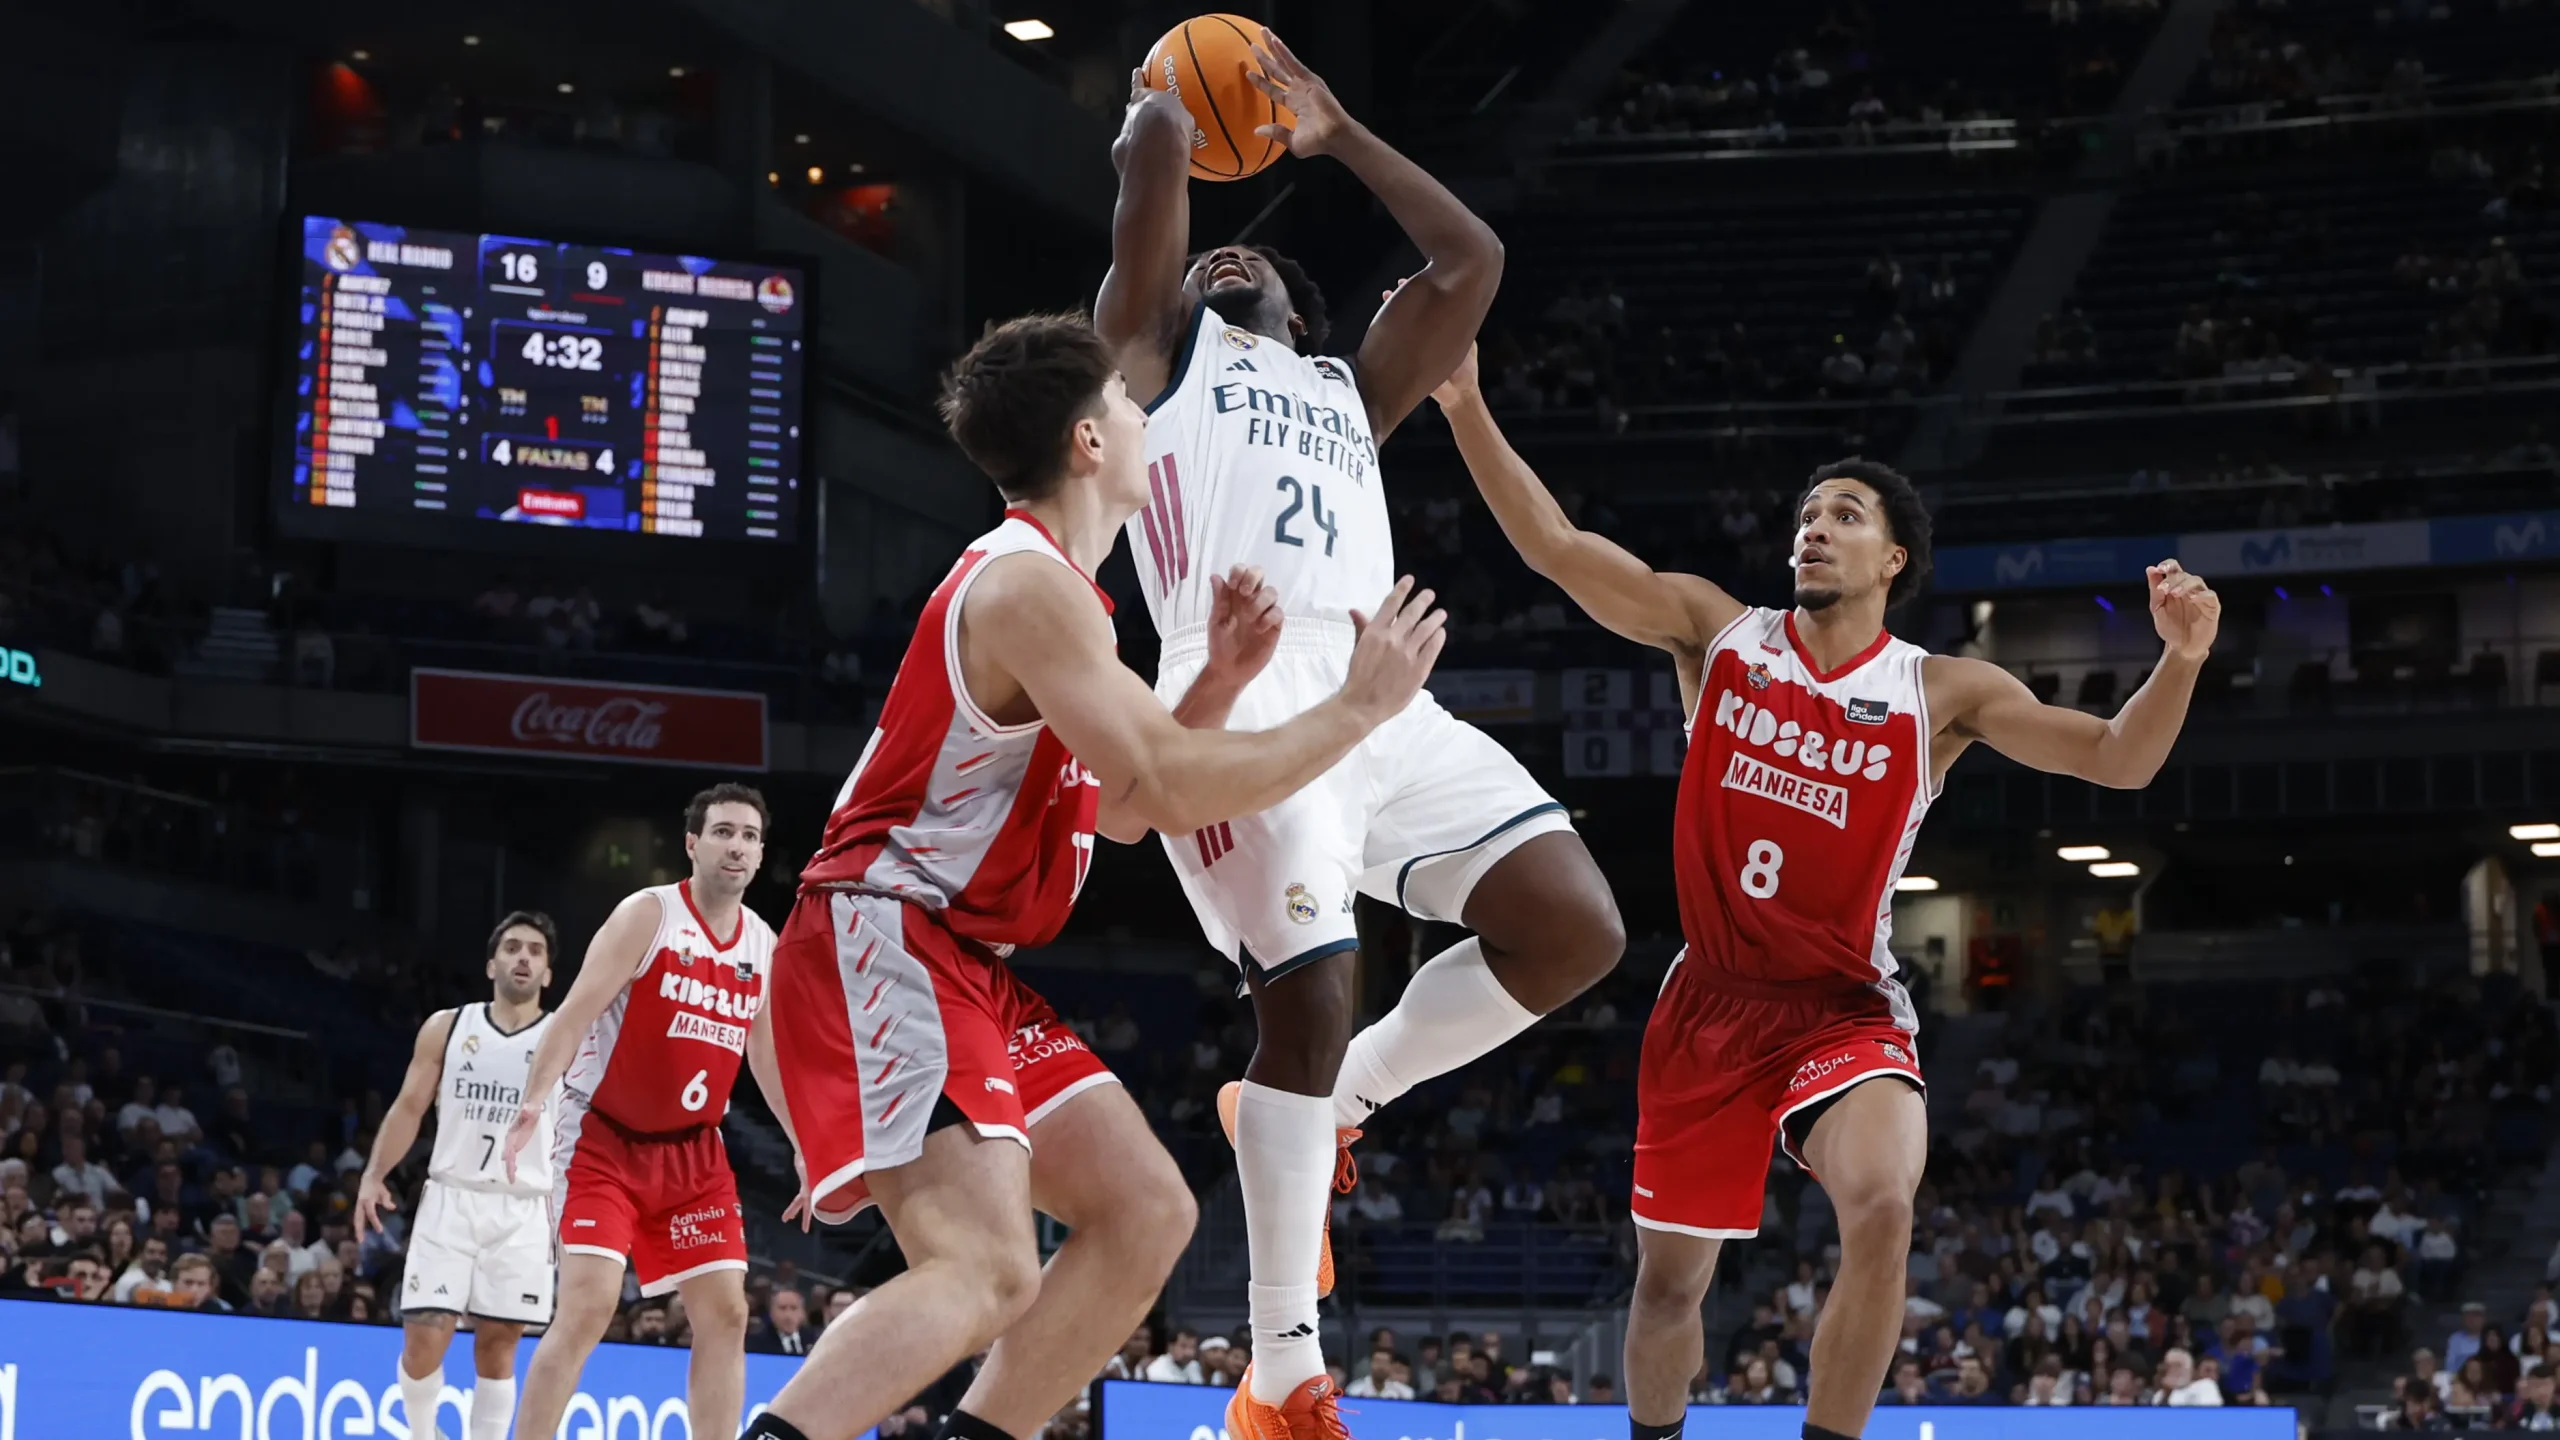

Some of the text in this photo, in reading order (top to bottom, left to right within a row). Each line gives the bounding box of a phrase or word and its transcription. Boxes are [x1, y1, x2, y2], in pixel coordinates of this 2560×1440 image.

[1163, 55, 1209, 150] lig desa
[500, 252, 538, 283] 16
[586, 261, 608, 290] 9
[521, 331, 603, 372] 4:32
[543, 414, 560, 441] 1
[1211, 381, 1376, 467] Emirates
[491, 439, 615, 475] 4 FALTAS 4
[1248, 417, 1365, 489] FLY BETTER
[1273, 475, 1339, 558] 24
[1850, 711, 1884, 722] endesa
[1851, 704, 1867, 713] liga
[1715, 688, 1892, 781] KIDS&US
[1730, 760, 1844, 821] MANRESA
[1740, 839, 1784, 899] 8
[674, 1014, 744, 1050] MANRESA
[454, 1077, 521, 1105] Emira
[680, 1069, 709, 1112] 6
[487, 1106, 519, 1125] BETT
[481, 1135, 496, 1171] 7
[672, 1231, 728, 1250] GLOBAL
